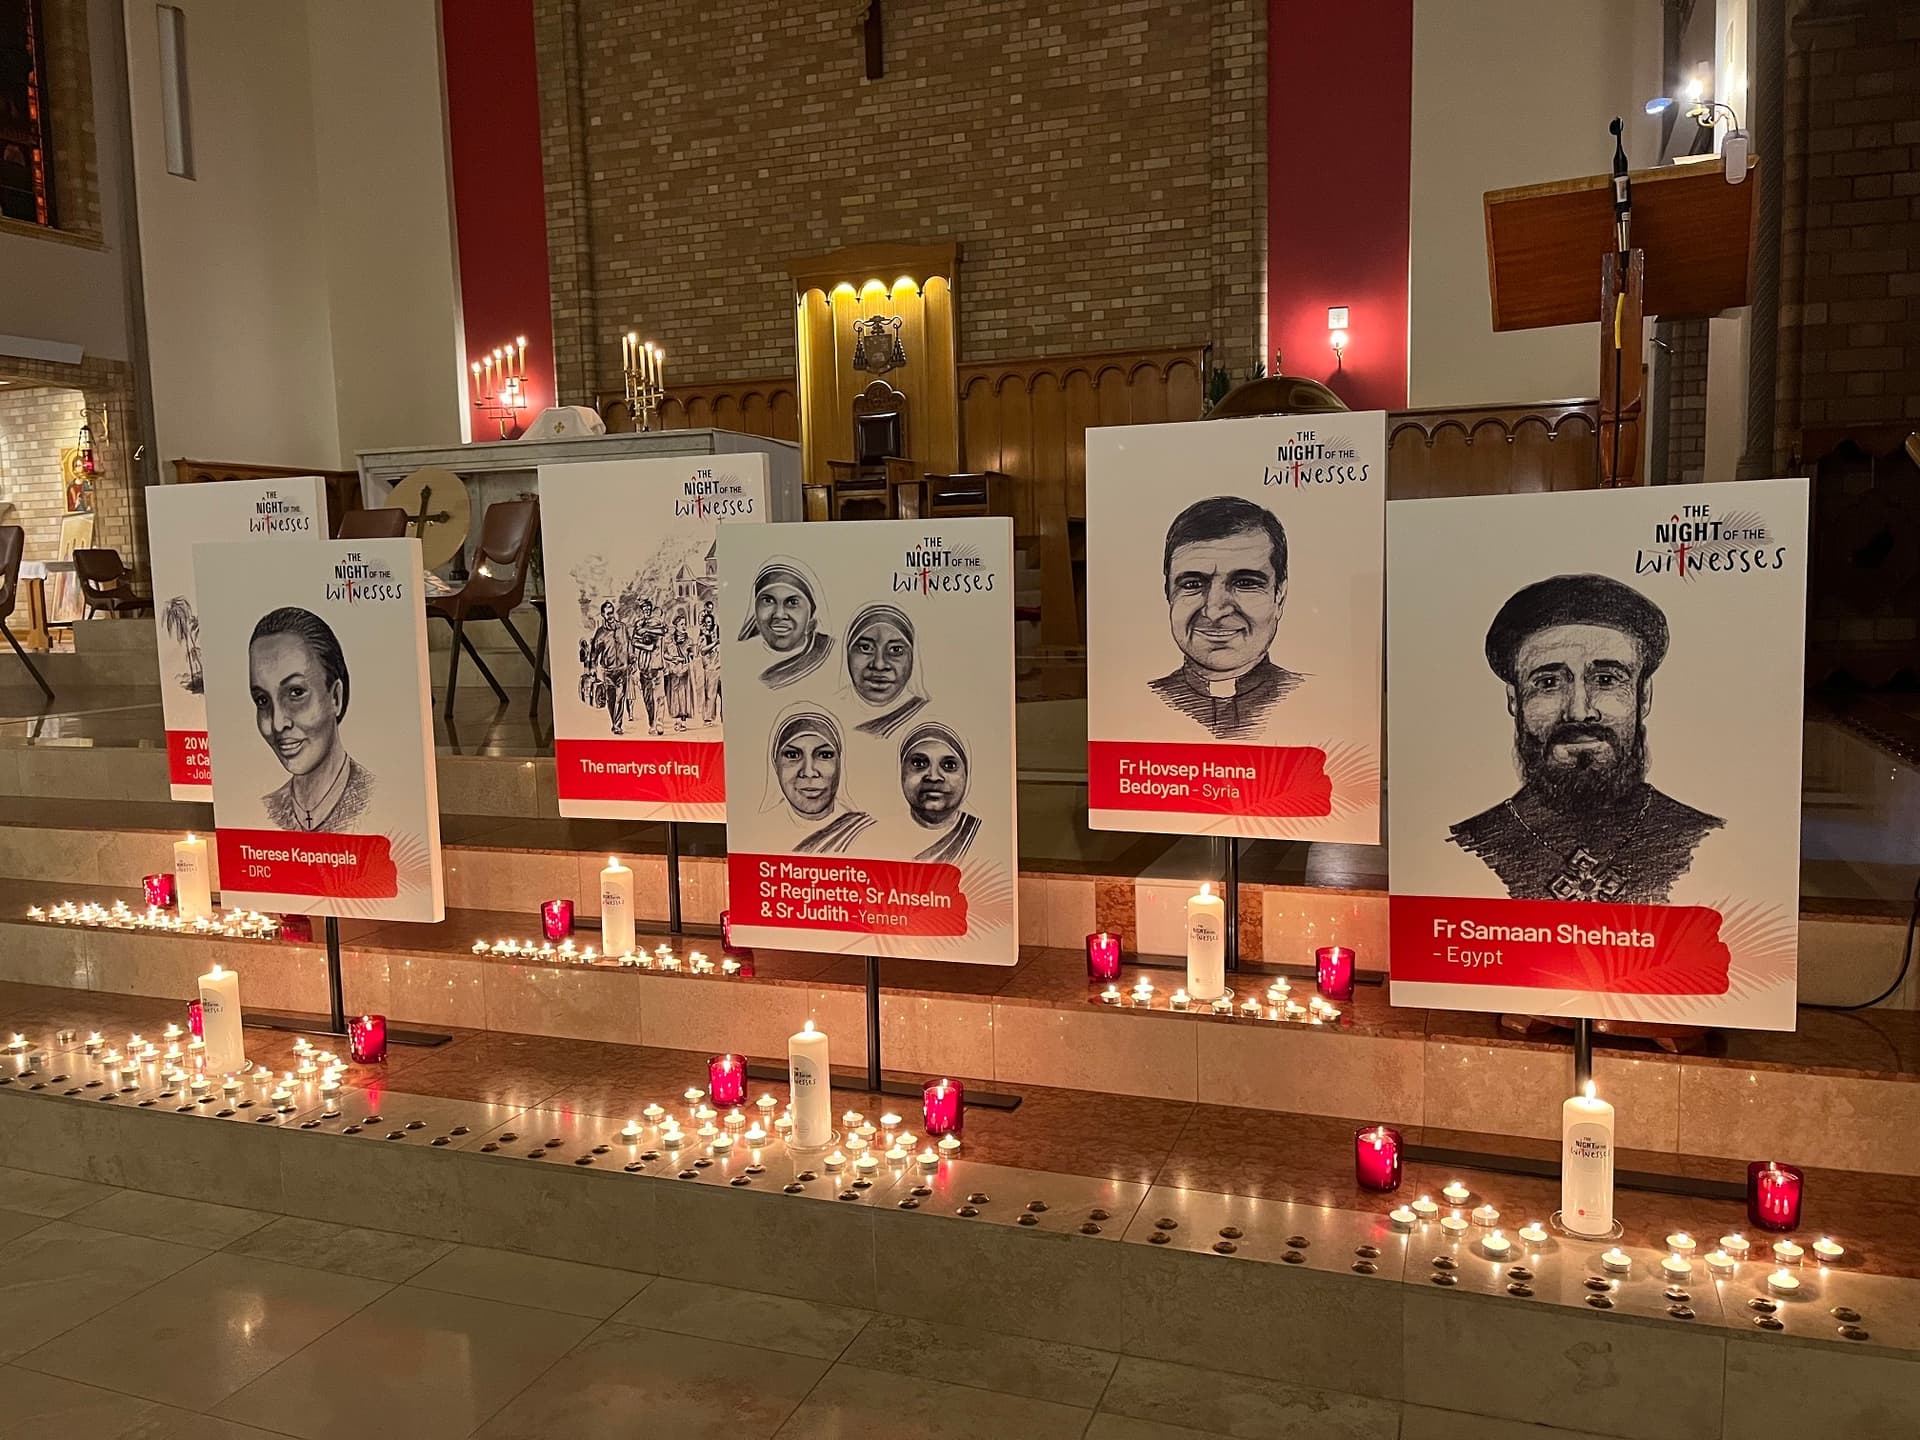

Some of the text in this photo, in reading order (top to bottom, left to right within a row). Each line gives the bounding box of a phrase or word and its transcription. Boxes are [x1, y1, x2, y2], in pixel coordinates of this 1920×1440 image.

[1296, 431, 1316, 441] THE
[1278, 439, 1355, 461] NIGHT OF THE
[698, 470, 712, 478] THE
[266, 491, 277, 499] THE
[684, 476, 719, 495] NIGHT
[256, 497, 283, 514] NIGHT
[1683, 505, 1709, 517] THE
[1656, 515, 1765, 543] NIGHT OF THE
[924, 537, 942, 547] THE
[348, 553, 361, 561] THE
[906, 544, 951, 567] NIGHT
[964, 558, 980, 566] THE
[335, 560, 368, 578] NIGHT
[184, 737, 198, 750] 20
[186, 754, 197, 766] at
[579, 759, 700, 779] The martyrs of Iraq
[1119, 759, 1256, 781] Fr Hovsep Hanna
[1119, 778, 1190, 799] Bedoyan
[1201, 783, 1241, 801] Syria
[239, 845, 358, 868] Therese Kapangala
[248, 864, 272, 879] DRC
[759, 861, 871, 885] Sr Marguerite,
[759, 881, 951, 909] Sr Reginette, Sr Anselm
[760, 901, 773, 919] &
[775, 902, 794, 919] Sr
[796, 903, 850, 923] Judith
[858, 908, 909, 926] Yemen
[1433, 919, 1656, 949] Fr Samaan Shehata
[1446, 945, 1504, 969] Egypt
[1575, 1139, 1596, 1150] NIGHT
